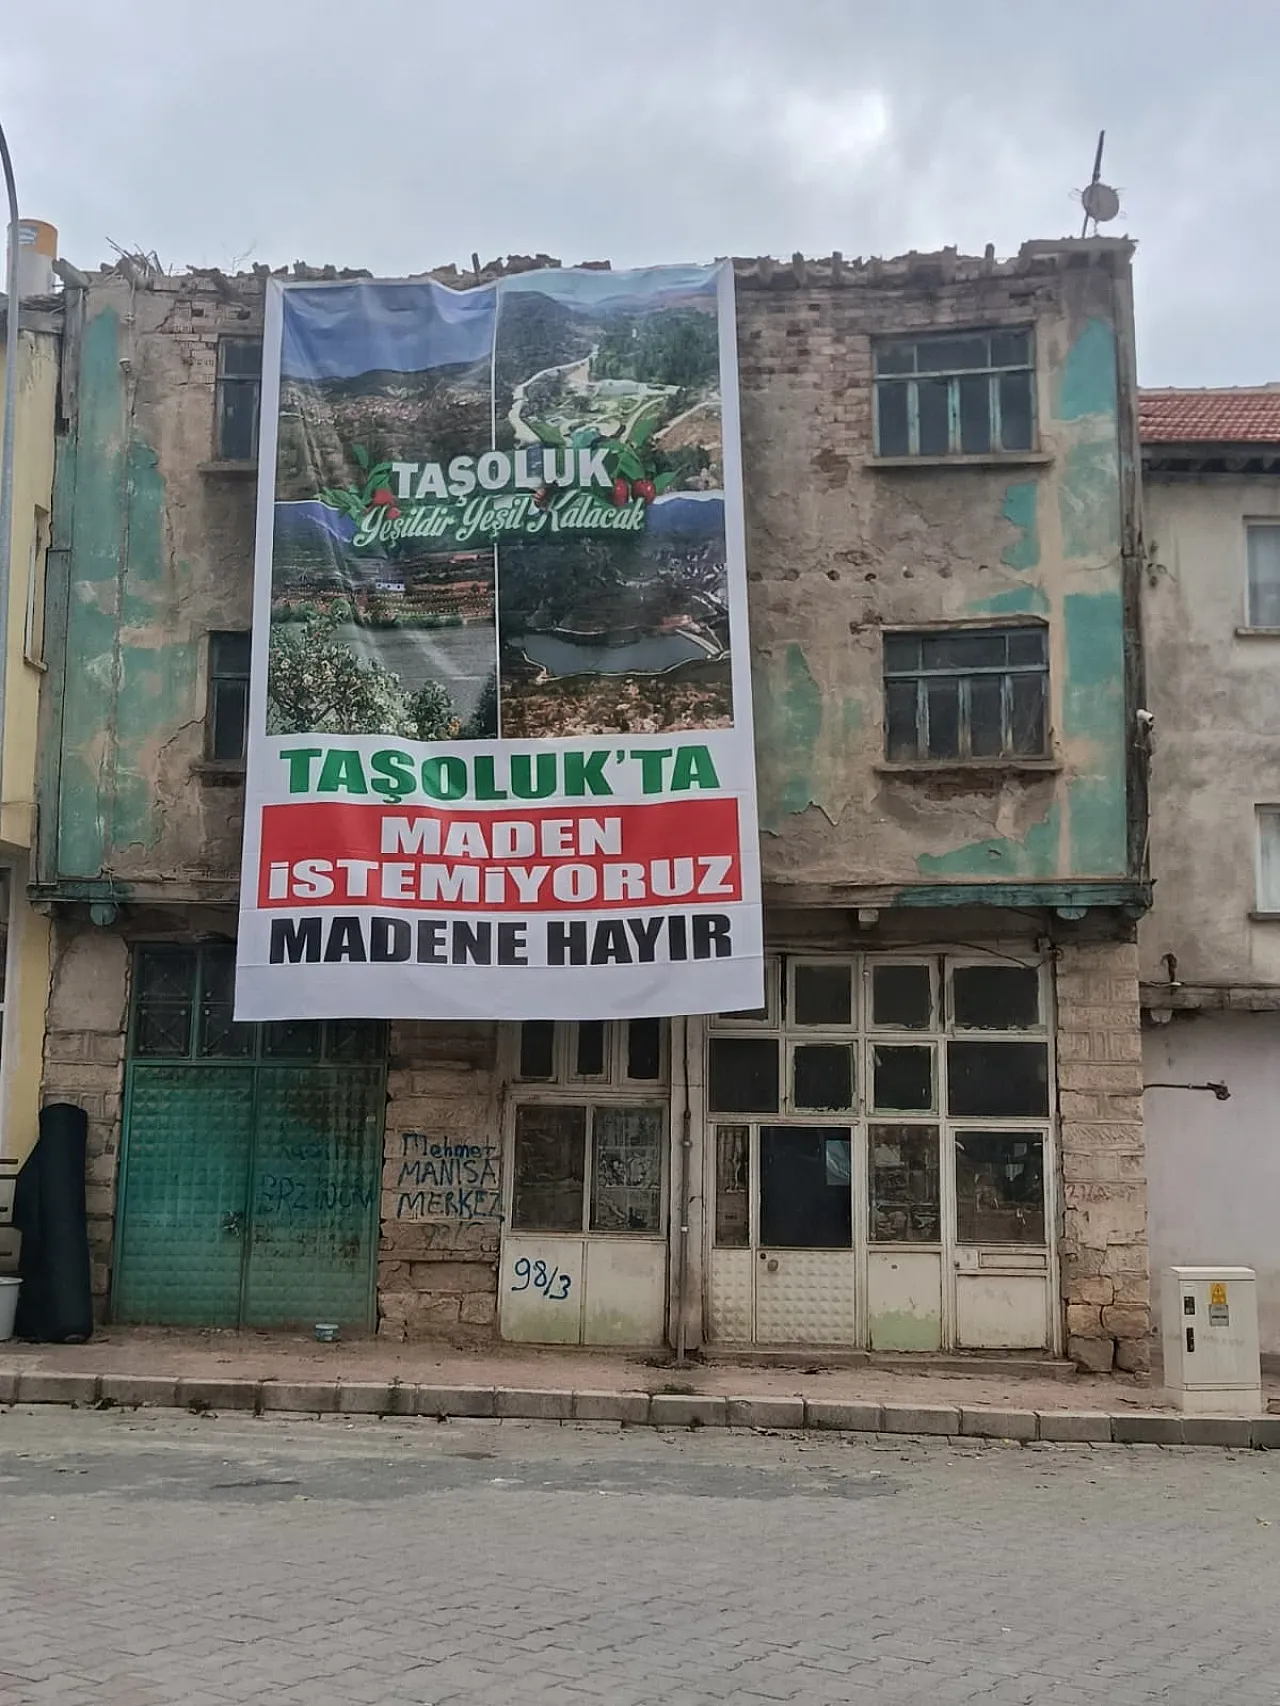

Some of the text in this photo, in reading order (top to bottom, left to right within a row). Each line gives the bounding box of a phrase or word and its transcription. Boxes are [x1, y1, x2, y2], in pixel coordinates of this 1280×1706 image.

[392, 447, 613, 506] TAŞOLUK
[353, 503, 455, 547] Yeşildir
[455, 493, 532, 540] Yeşil
[280, 744, 720, 803] TAŞOLUK'TA
[380, 816, 622, 859] MADEN
[269, 913, 732, 965] MADENE HAYIR
[401, 1132, 497, 1159] Mehmet
[397, 1187, 505, 1220] MERKEZ
[511, 1257, 572, 1300] 98/3
